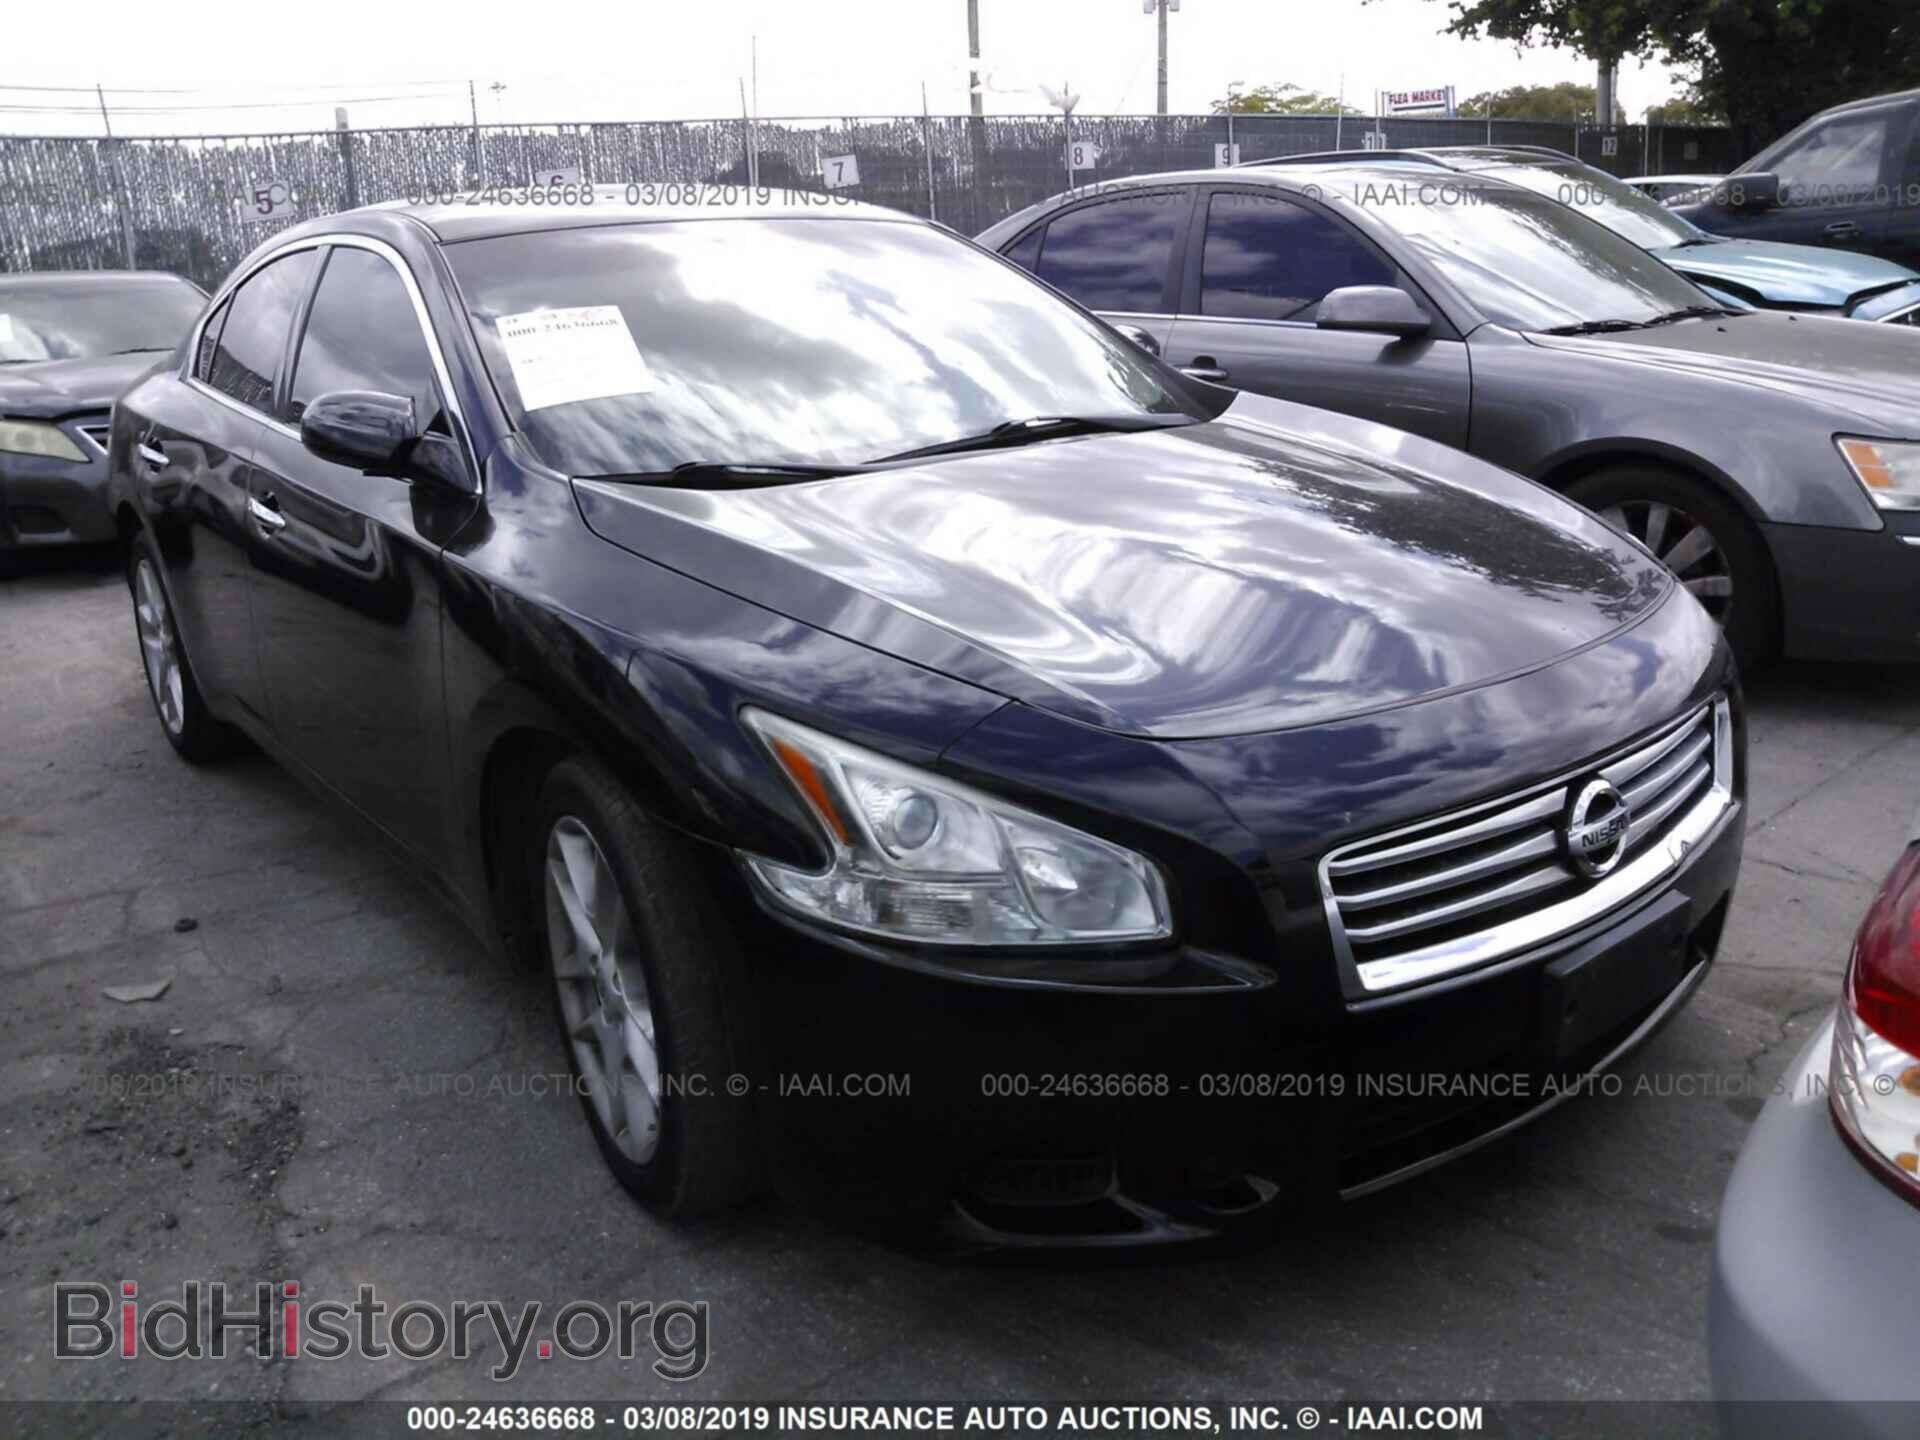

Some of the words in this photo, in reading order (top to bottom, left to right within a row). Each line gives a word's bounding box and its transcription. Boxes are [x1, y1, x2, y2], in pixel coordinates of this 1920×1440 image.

[1073, 146, 1083, 166] 8
[831, 161, 844, 182] 7
[256, 190, 273, 215] 5
